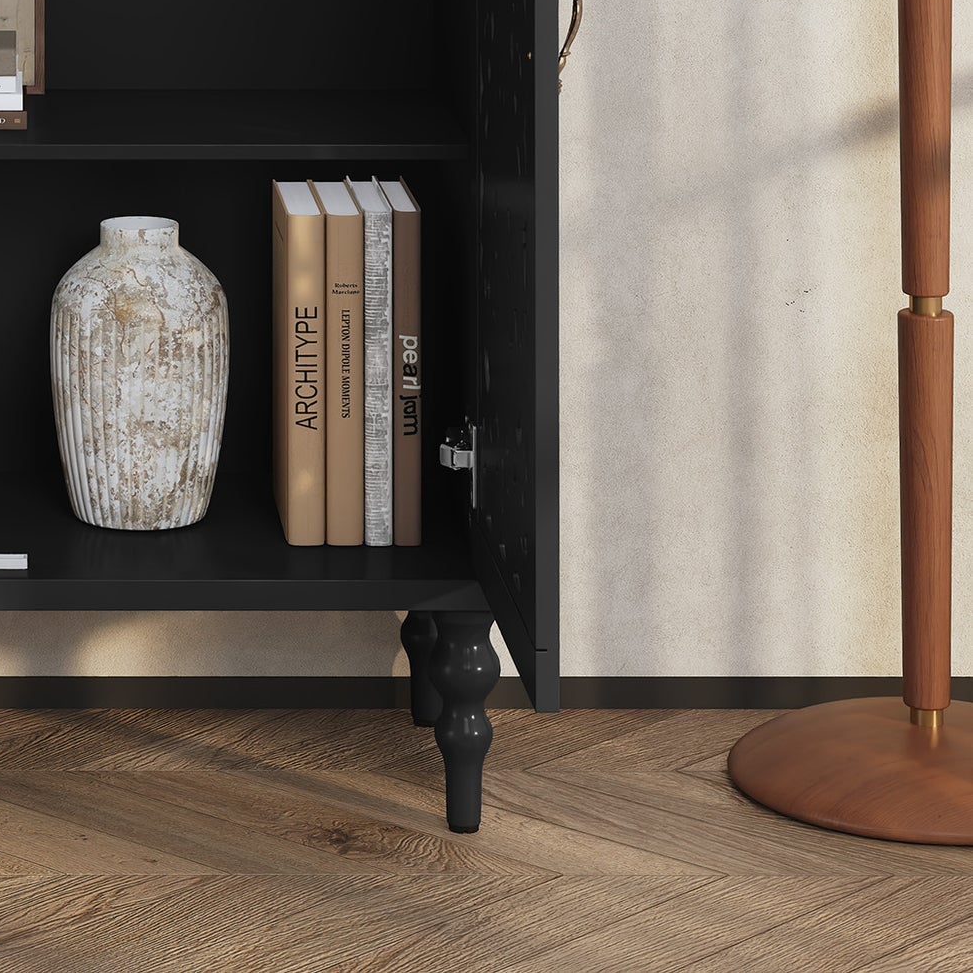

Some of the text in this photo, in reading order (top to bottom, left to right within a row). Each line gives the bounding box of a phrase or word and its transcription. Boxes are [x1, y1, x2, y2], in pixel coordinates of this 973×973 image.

[295, 306, 318, 430] ARCHITYPE
[341, 309, 350, 419] LEPTON DIPOLE MOMENTS
[399, 334, 422, 436] pearl jam
